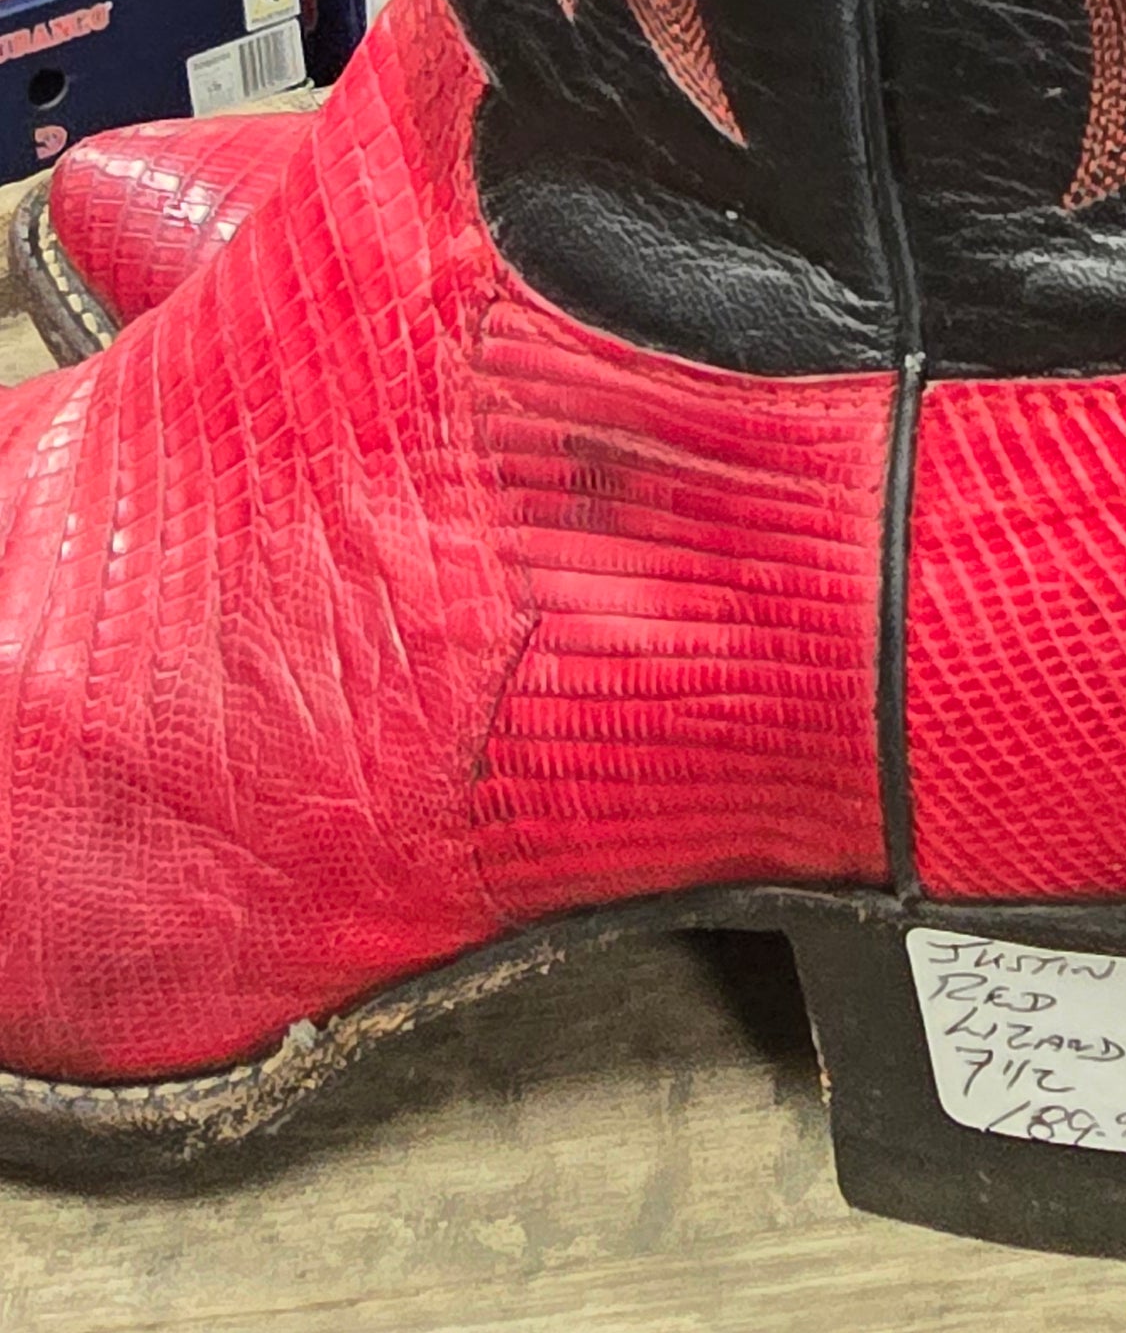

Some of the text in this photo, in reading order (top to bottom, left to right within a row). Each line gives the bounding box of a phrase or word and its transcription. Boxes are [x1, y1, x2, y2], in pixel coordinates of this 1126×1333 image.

[927, 941, 1117, 980] JUSTIN
[928, 972, 1057, 1012] RED
[944, 1007, 1126, 1062] LIZARD
